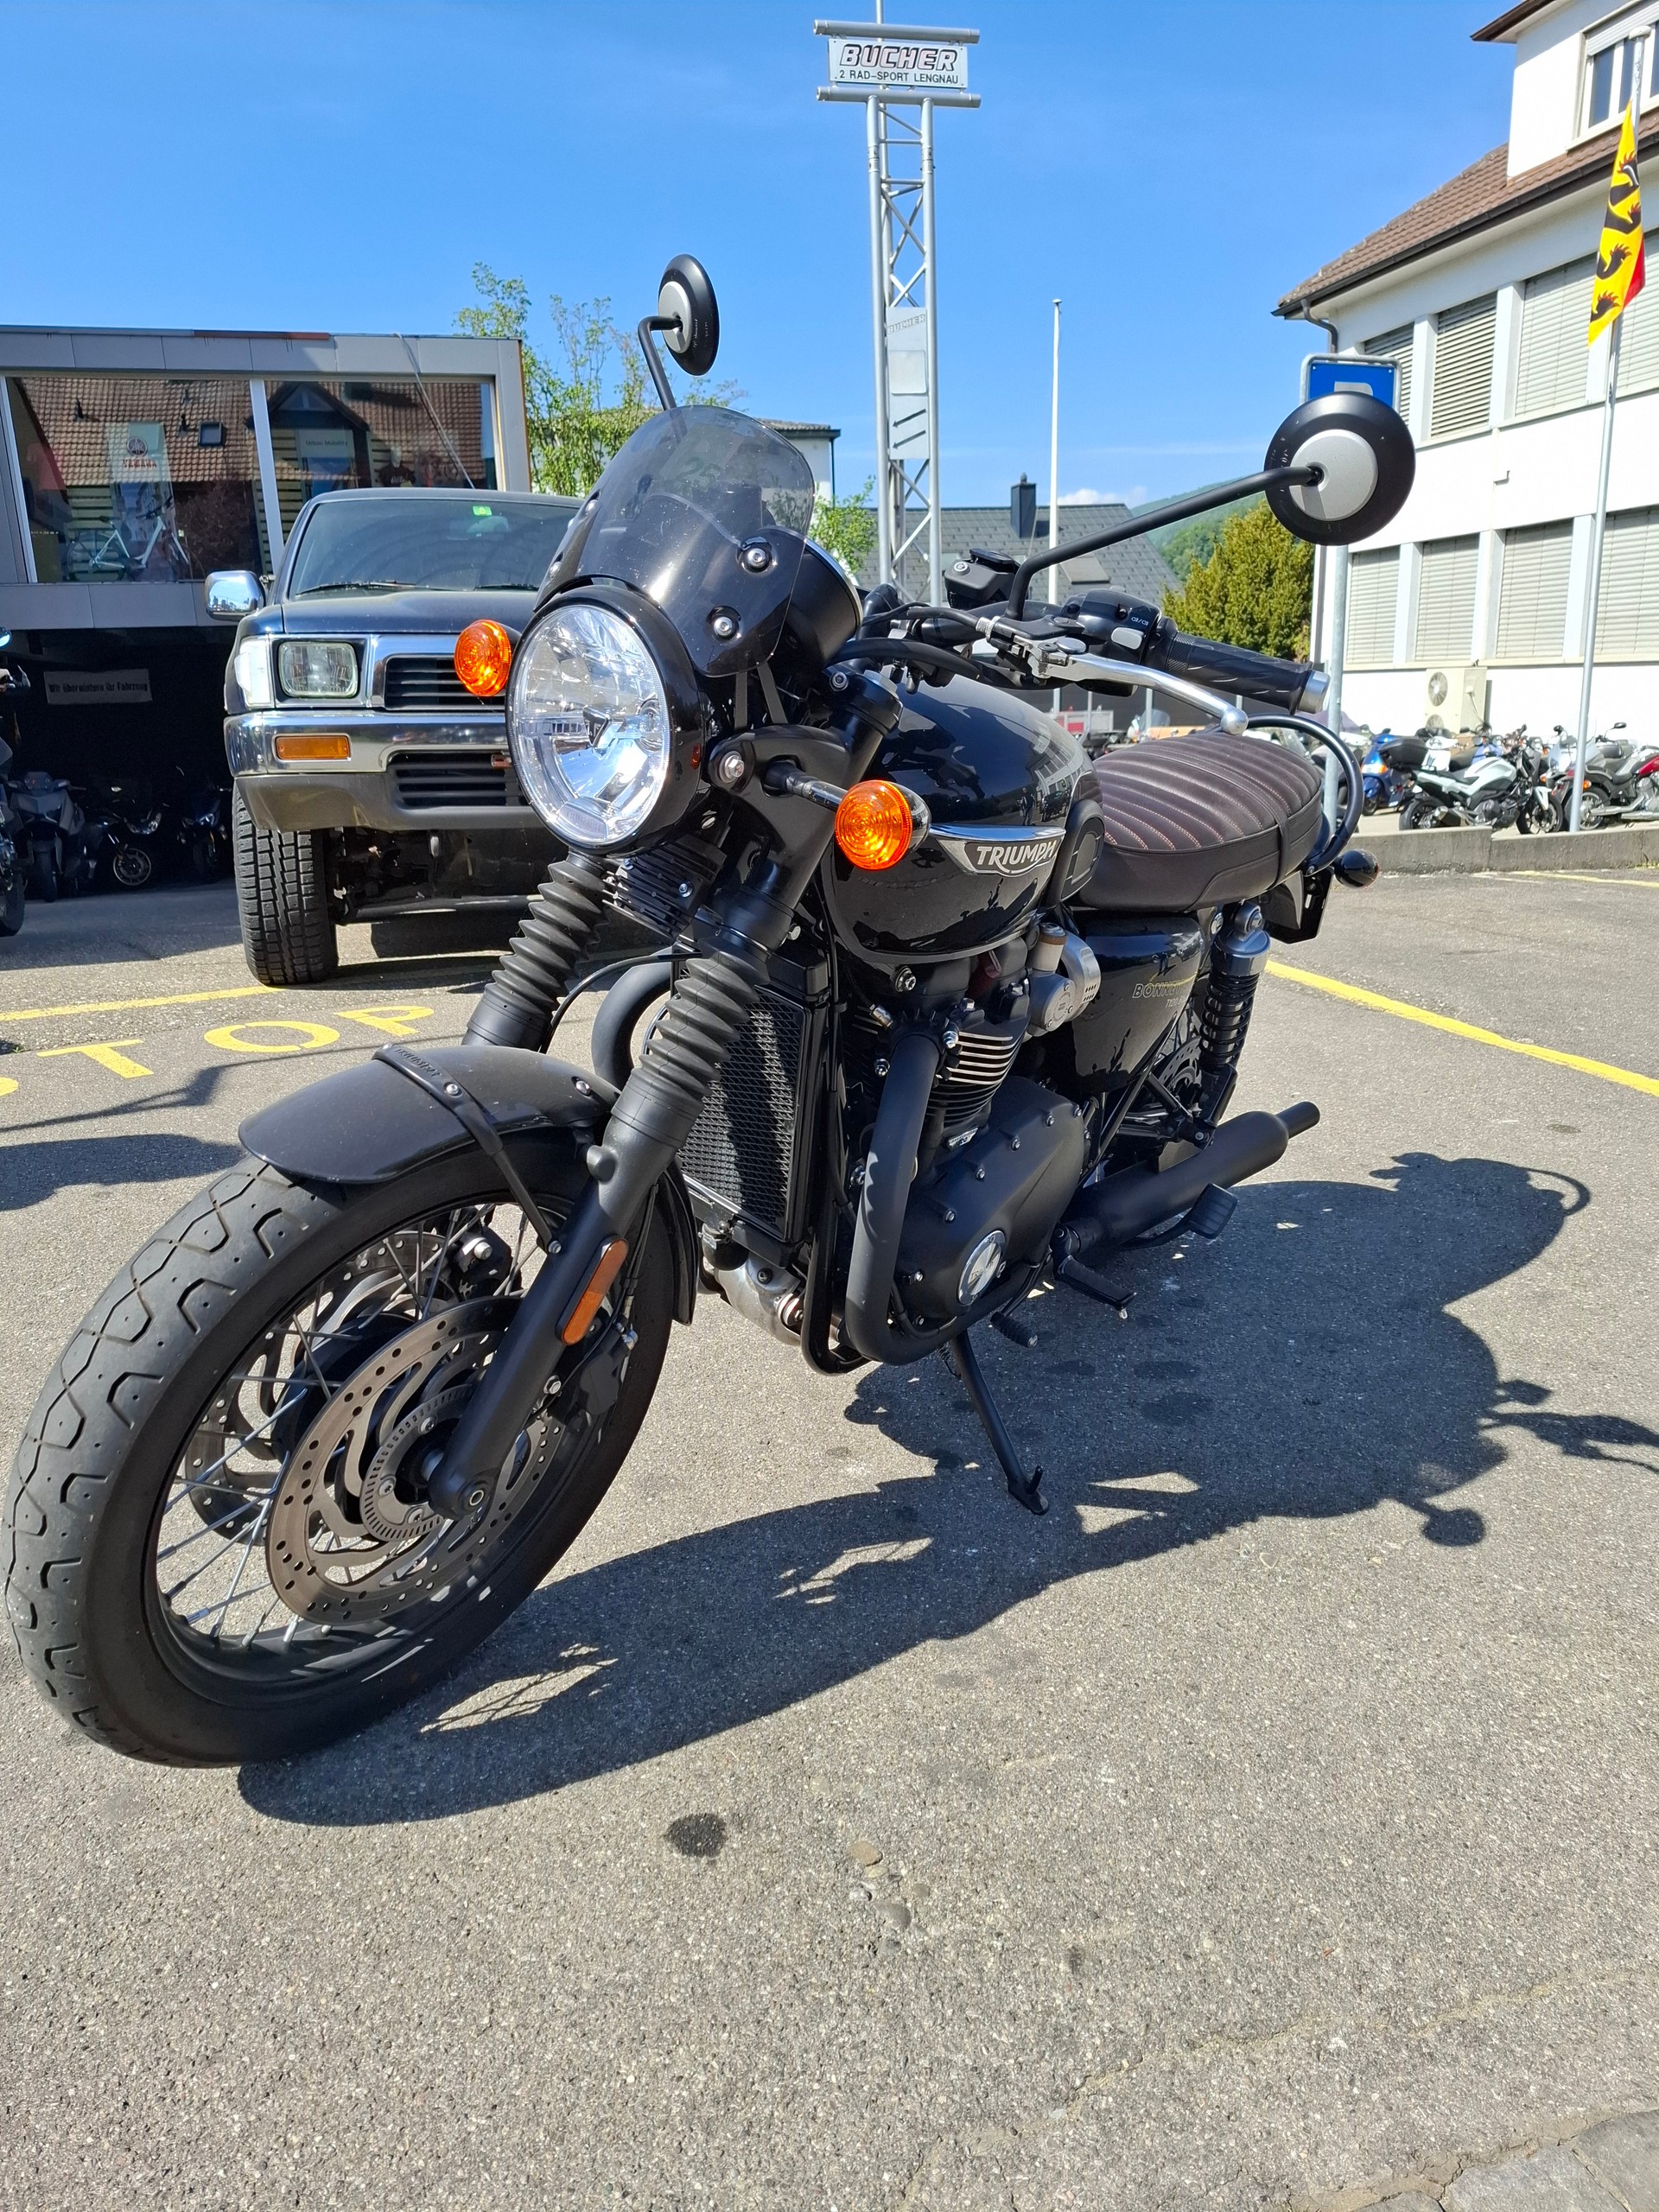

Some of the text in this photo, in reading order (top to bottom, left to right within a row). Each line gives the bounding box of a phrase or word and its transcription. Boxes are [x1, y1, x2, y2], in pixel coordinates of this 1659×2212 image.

[839, 44, 957, 71] BUCHER
[839, 69, 845, 79] 2
[914, 73, 958, 84] LENGNAU
[887, 314, 925, 334] BUCHER
[976, 840, 1057, 874] TRIUMPH
